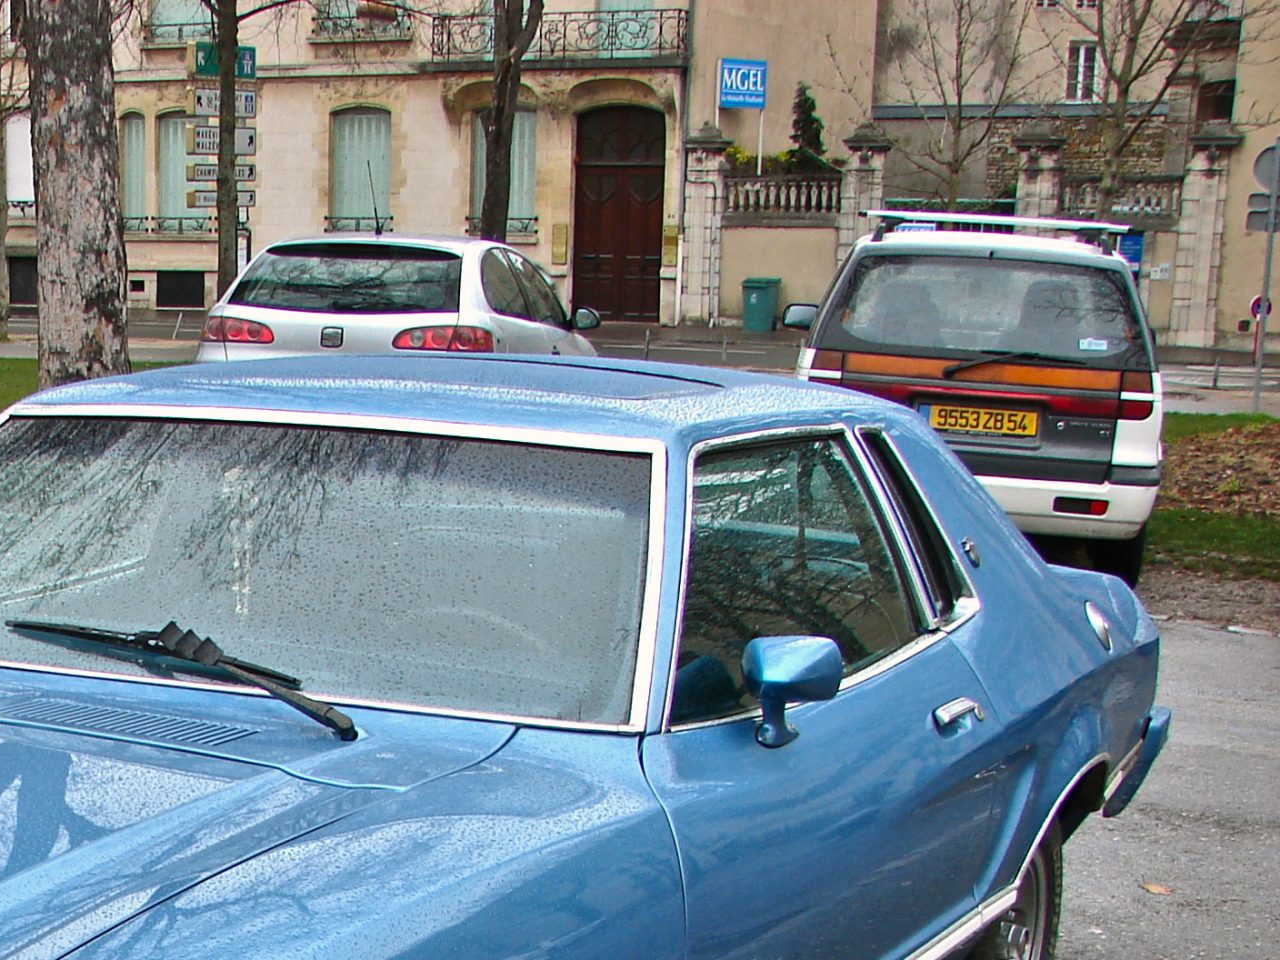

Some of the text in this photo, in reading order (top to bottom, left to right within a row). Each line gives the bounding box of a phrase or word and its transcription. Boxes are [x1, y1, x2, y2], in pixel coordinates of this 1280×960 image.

[722, 68, 764, 91] MGEL
[937, 408, 1028, 433] 9553 ZB 54
